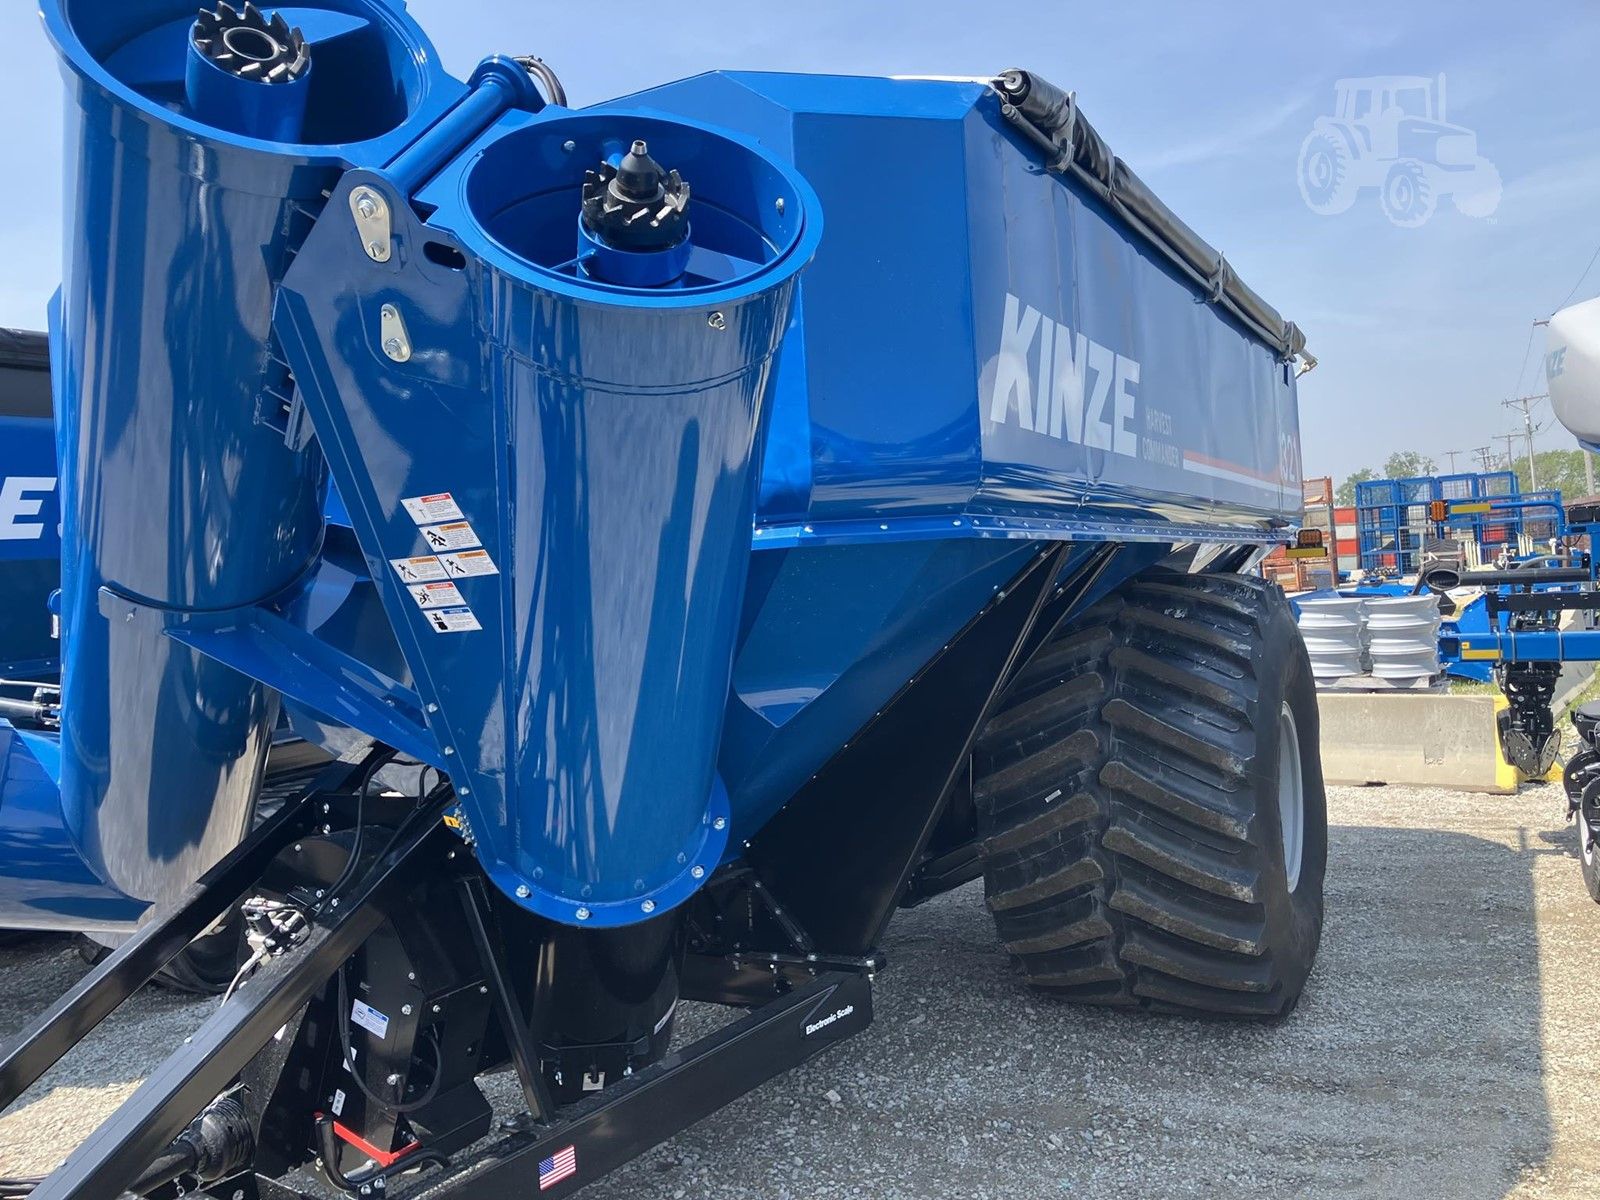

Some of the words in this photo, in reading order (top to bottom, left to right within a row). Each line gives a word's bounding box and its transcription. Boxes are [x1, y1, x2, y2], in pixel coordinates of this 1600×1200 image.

[990, 293, 1140, 458] KINZE
[805, 1013, 837, 1035] Electronic
[836, 1005, 854, 1019] Scale
